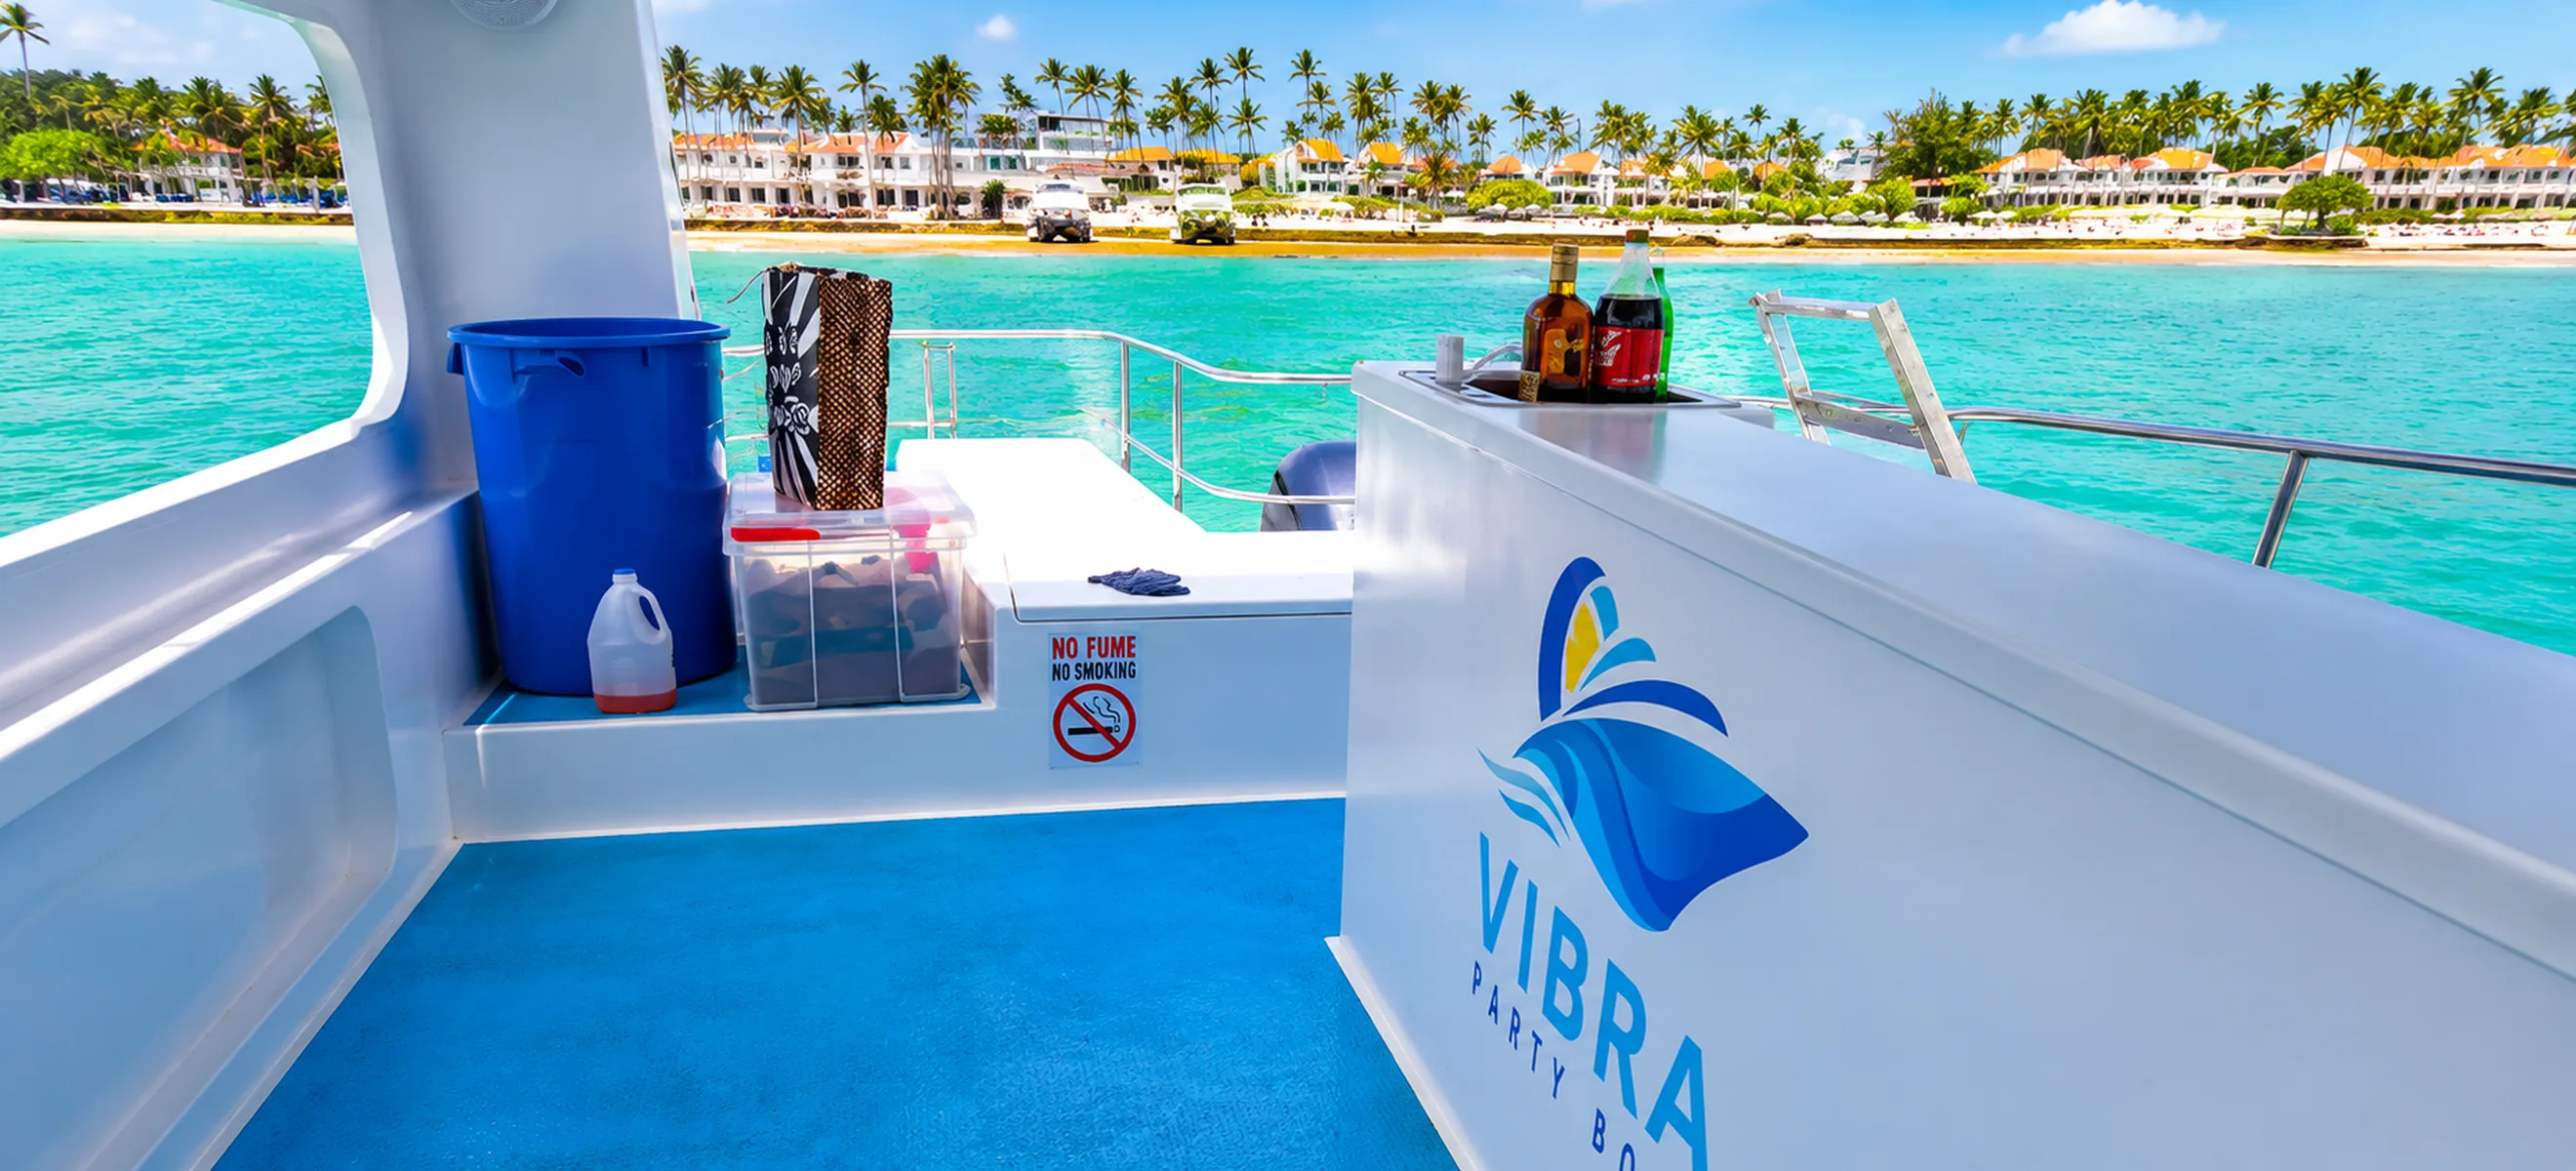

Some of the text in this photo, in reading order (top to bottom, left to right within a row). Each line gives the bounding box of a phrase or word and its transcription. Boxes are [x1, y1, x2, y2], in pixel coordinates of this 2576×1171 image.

[1052, 635, 1137, 660] NO FUME
[1052, 661, 1137, 681] NO SMOKING
[1471, 960, 1566, 1099] PARTY
[1479, 830, 1710, 1171] VIBRA
